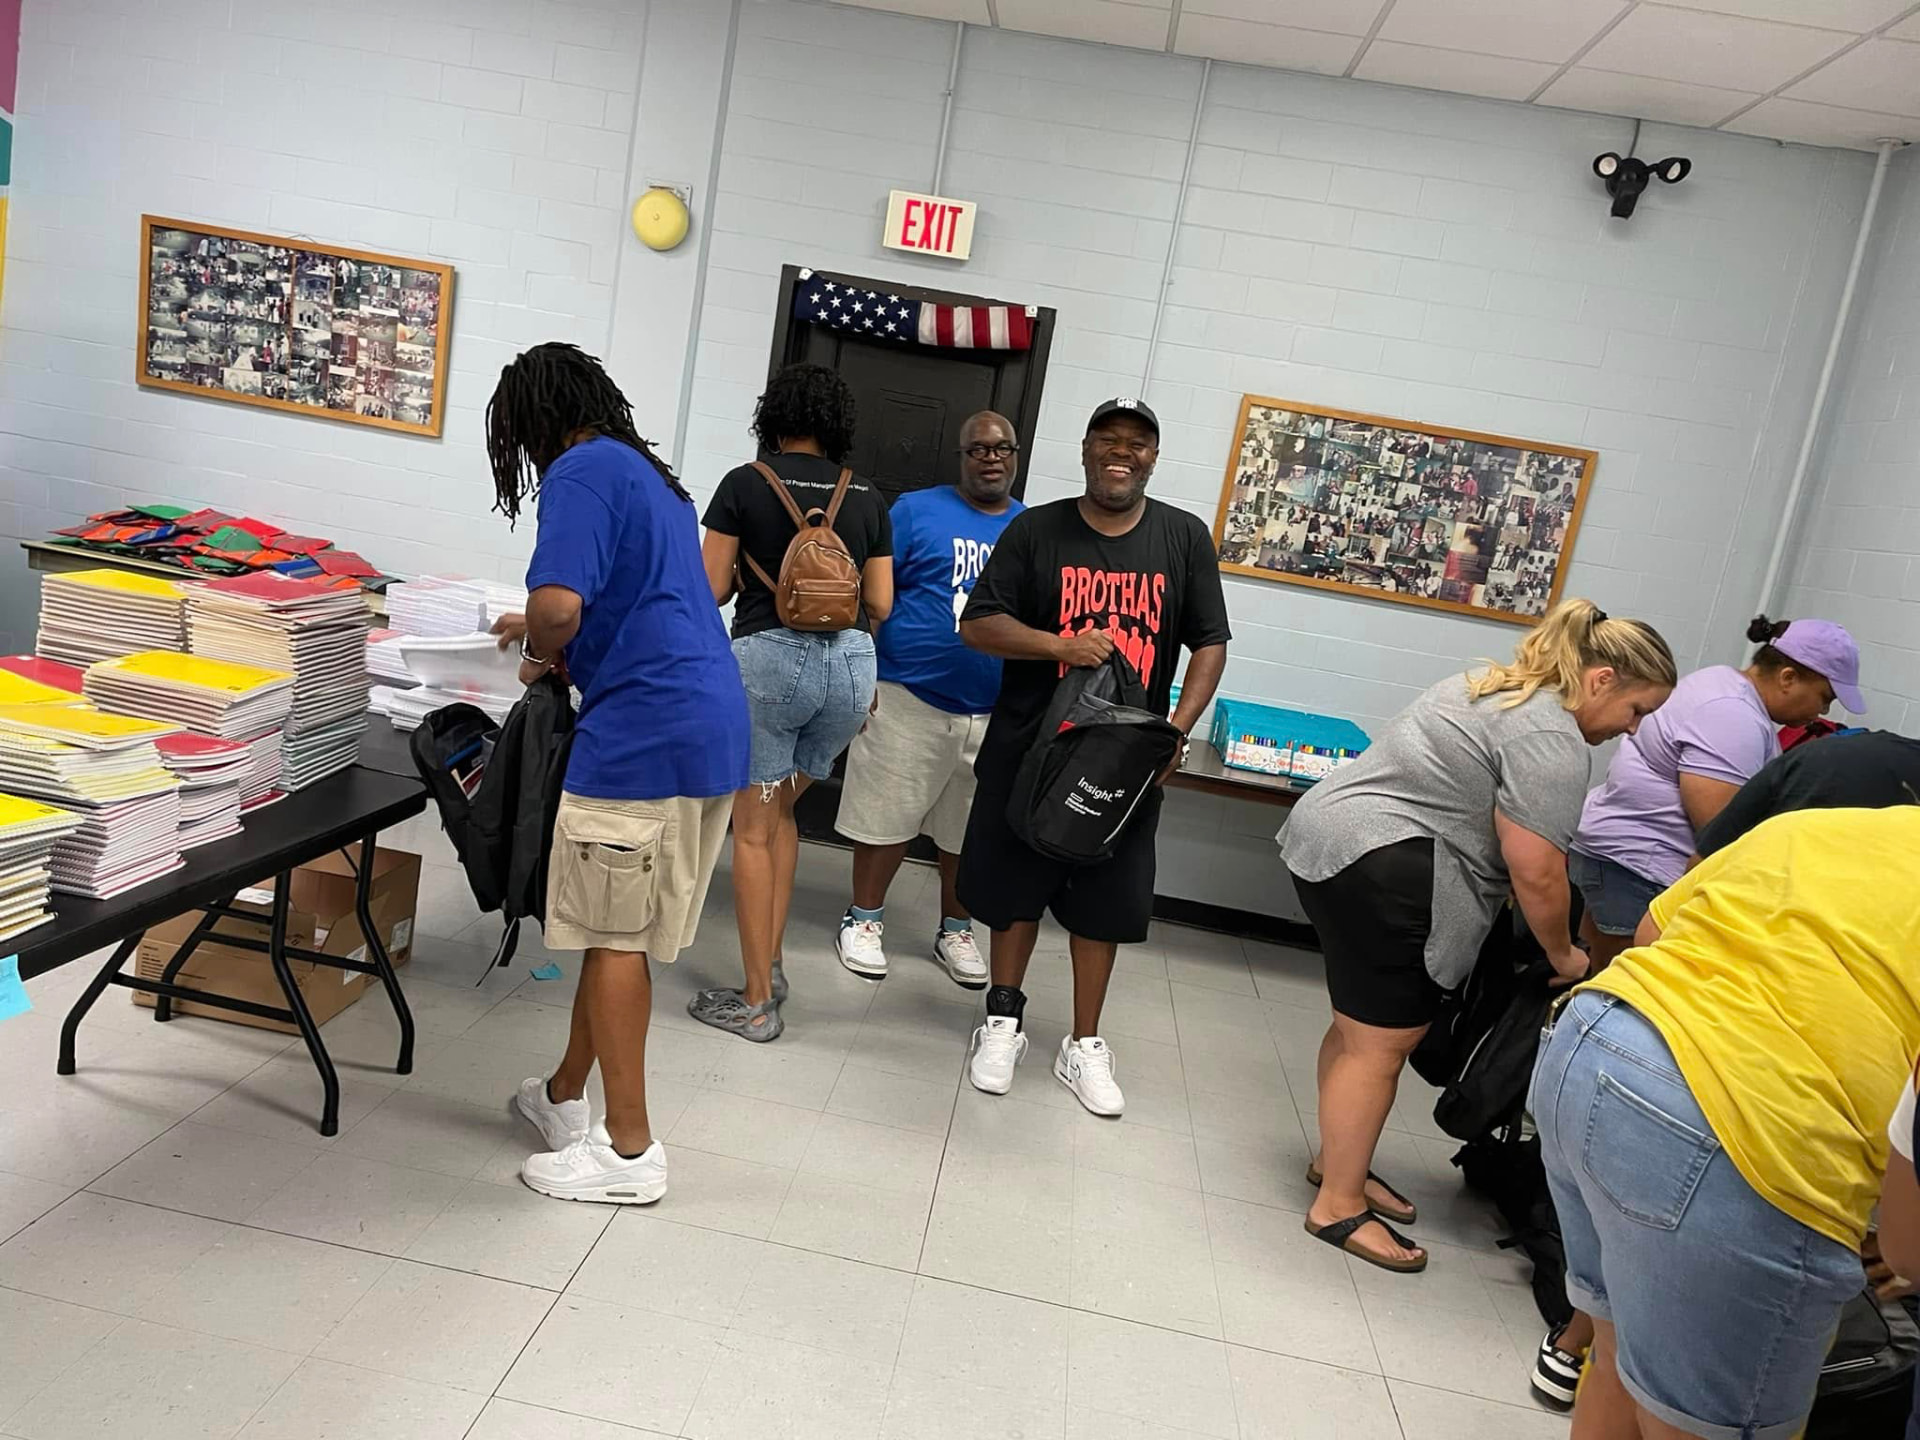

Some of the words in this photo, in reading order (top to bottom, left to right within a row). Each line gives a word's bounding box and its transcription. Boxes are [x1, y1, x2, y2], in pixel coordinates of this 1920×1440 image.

[901, 199, 963, 253] EXIT
[951, 537, 995, 588] BRO
[1060, 566, 1165, 634] BROTHAS
[1077, 776, 1113, 802] Insight
